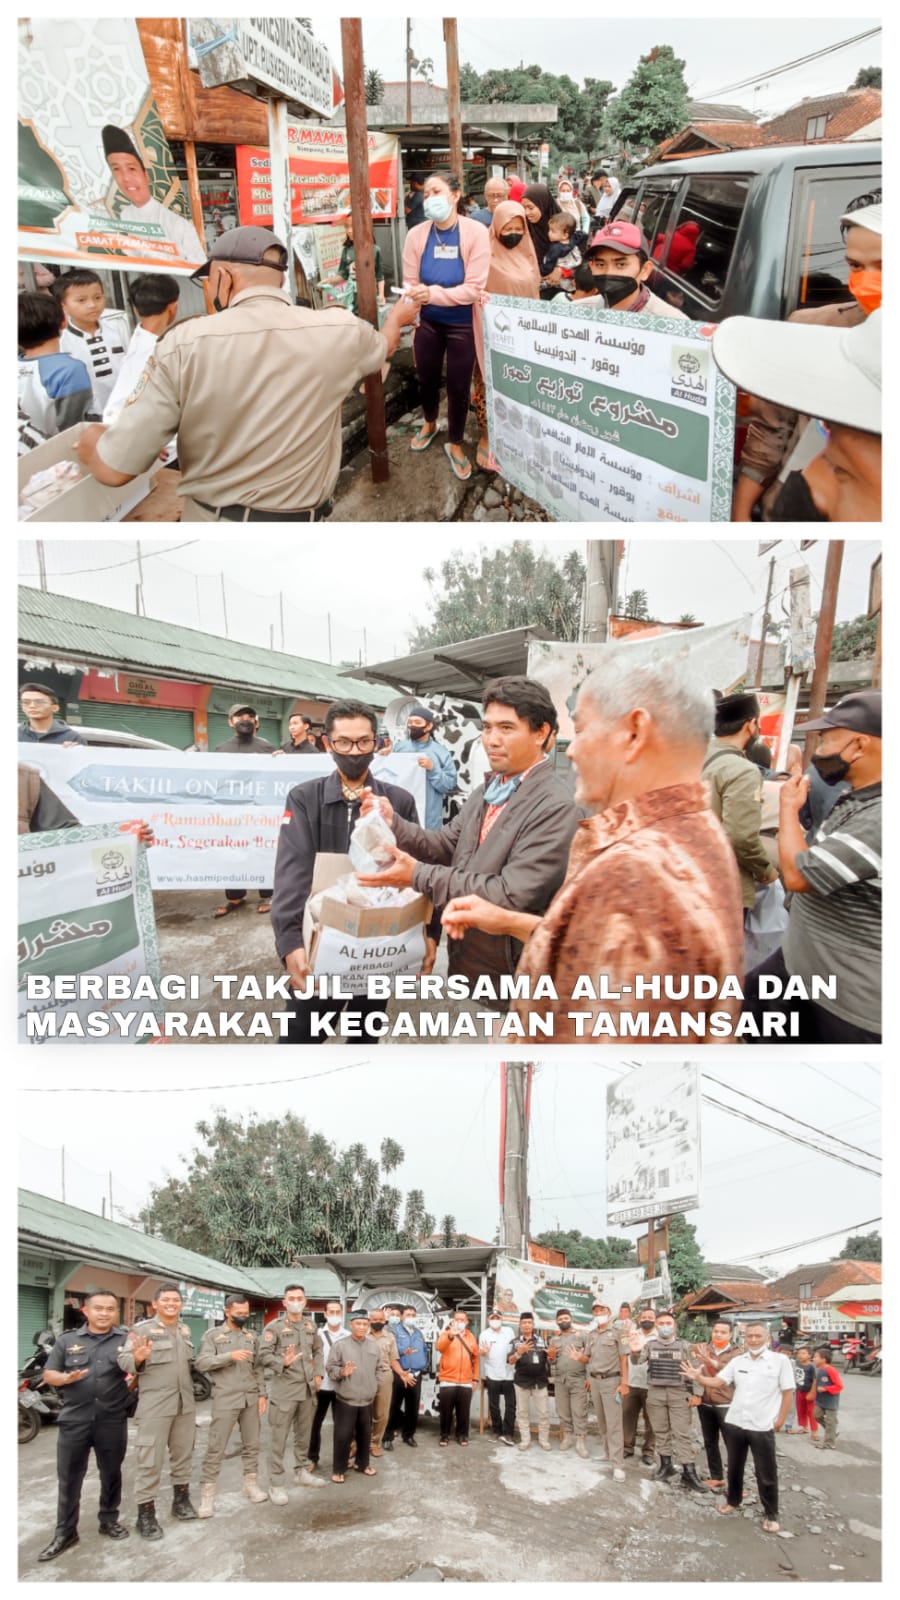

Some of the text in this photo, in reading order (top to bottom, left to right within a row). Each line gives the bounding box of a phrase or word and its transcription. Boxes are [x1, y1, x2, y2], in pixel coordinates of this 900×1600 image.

[299, 128, 345, 145] MAMA
[79, 235, 113, 246] CAMAT
[502, 363, 679, 438] مشروع توزيع تمور
[102, 775, 171, 796] TAKJIL
[186, 777, 218, 795] ON
[224, 779, 266, 796] THE
[156, 873, 266, 884] www.hasmipeduli.org
[339, 943, 407, 960] AL HUDA
[350, 962, 393, 972] BERBAGI
